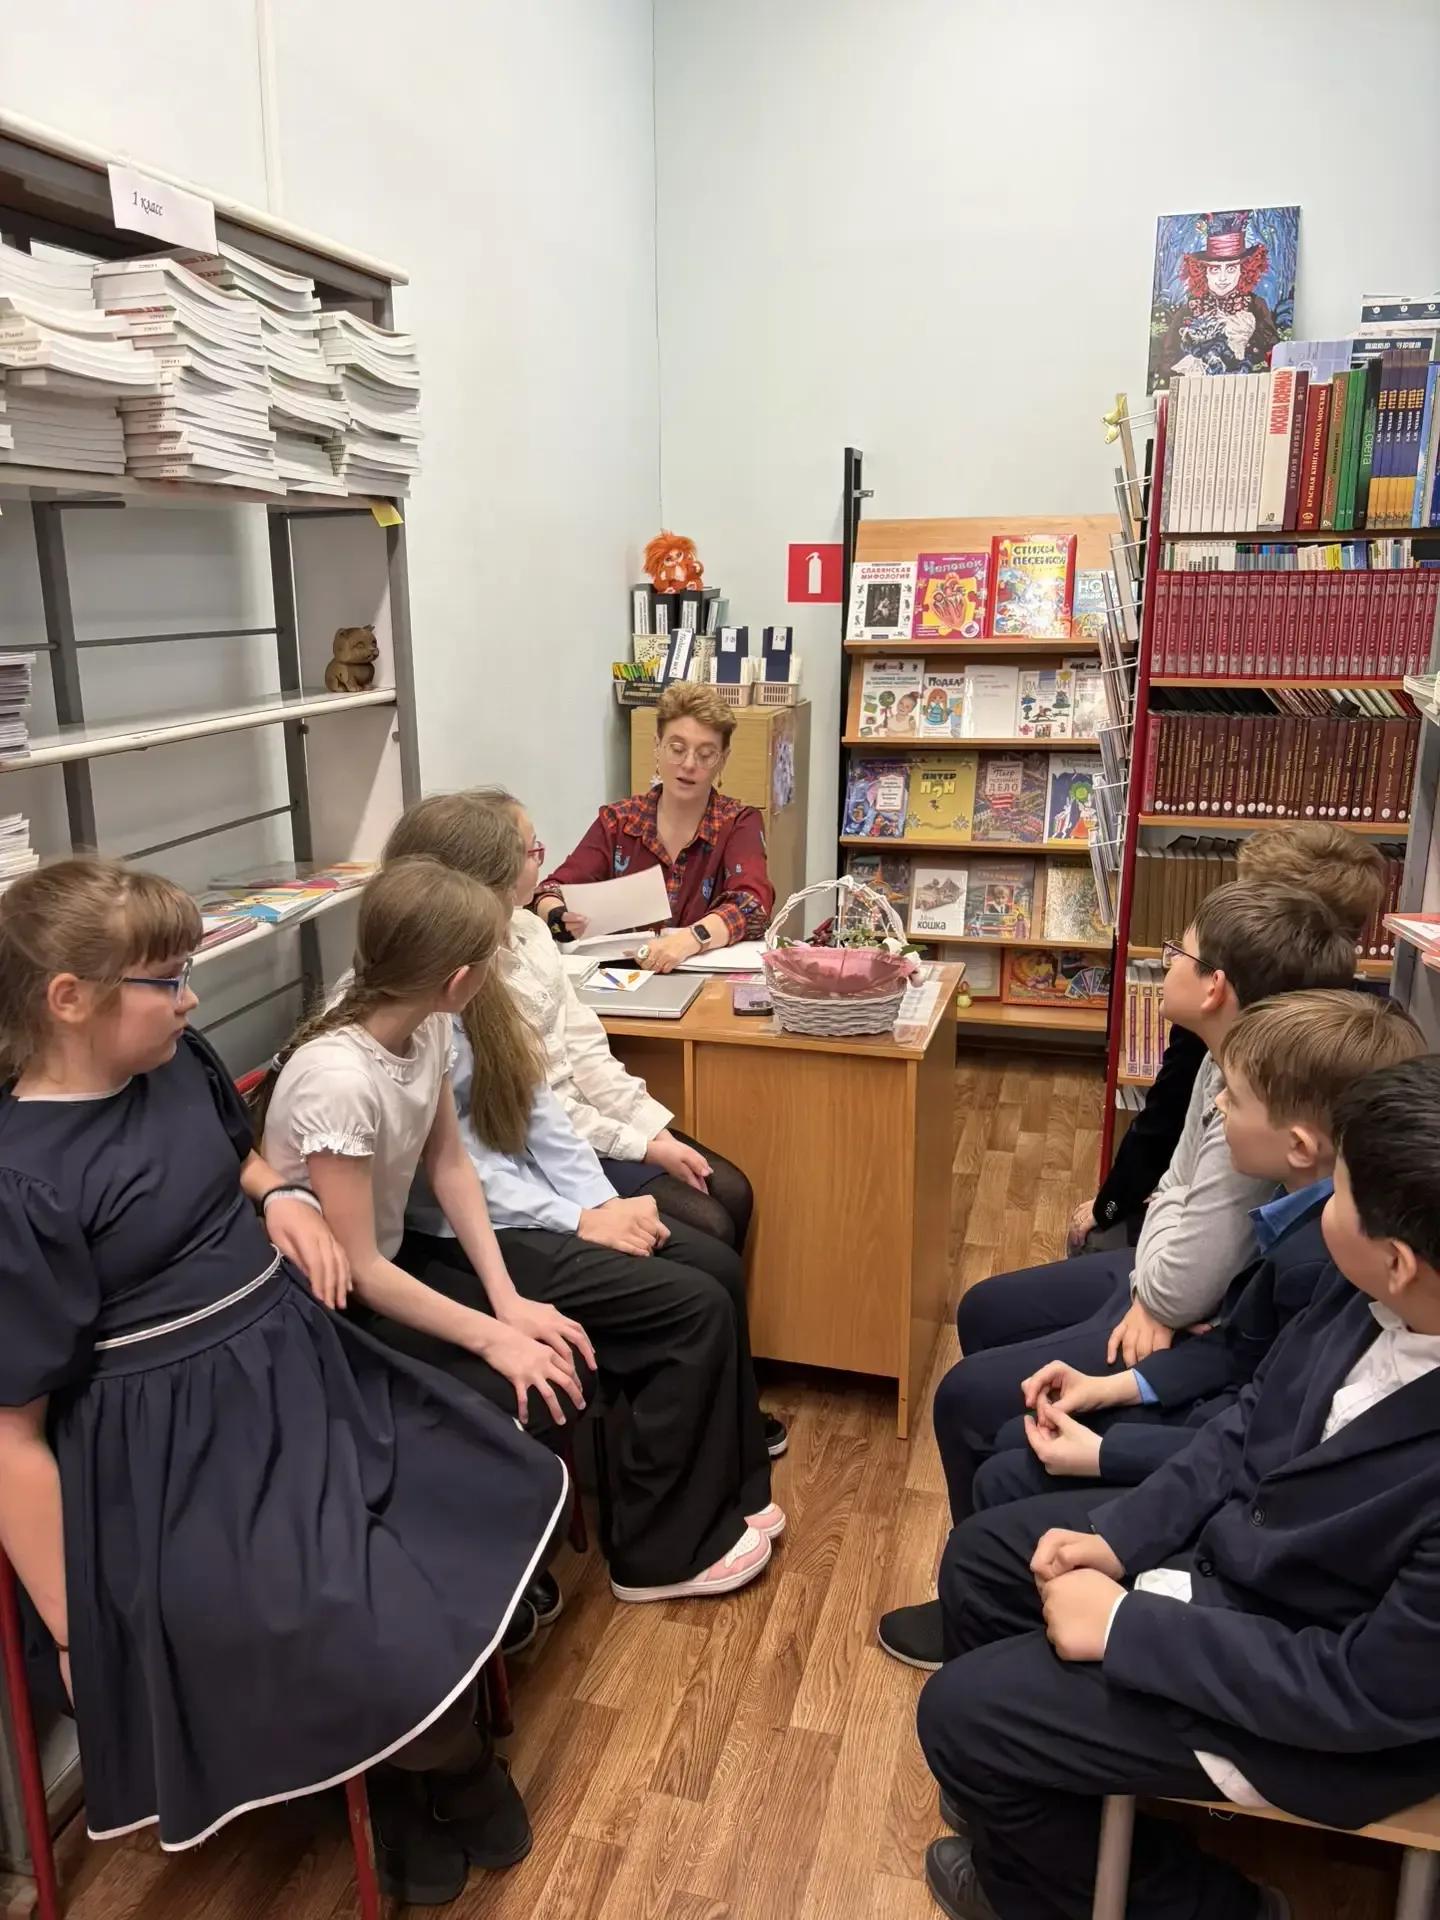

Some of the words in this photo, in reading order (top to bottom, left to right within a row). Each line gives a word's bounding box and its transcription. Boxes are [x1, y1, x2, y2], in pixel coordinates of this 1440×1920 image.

[132, 190, 137, 206] 1
[140, 197, 163, 216] класс
[1272, 371, 1293, 404] ВОЕННАЯ
[1317, 389, 1327, 421] МОСКВЫ
[1270, 405, 1289, 435] МОСКВА
[1313, 423, 1323, 450] ГОРОДА
[1310, 452, 1319, 475] КНИГА
[1307, 477, 1316, 508] КРАСНАЯ
[923, 560, 983, 575] Человек
[920, 781, 955, 798] ПЭН
[988, 783, 1018, 792] ДЕЛО
